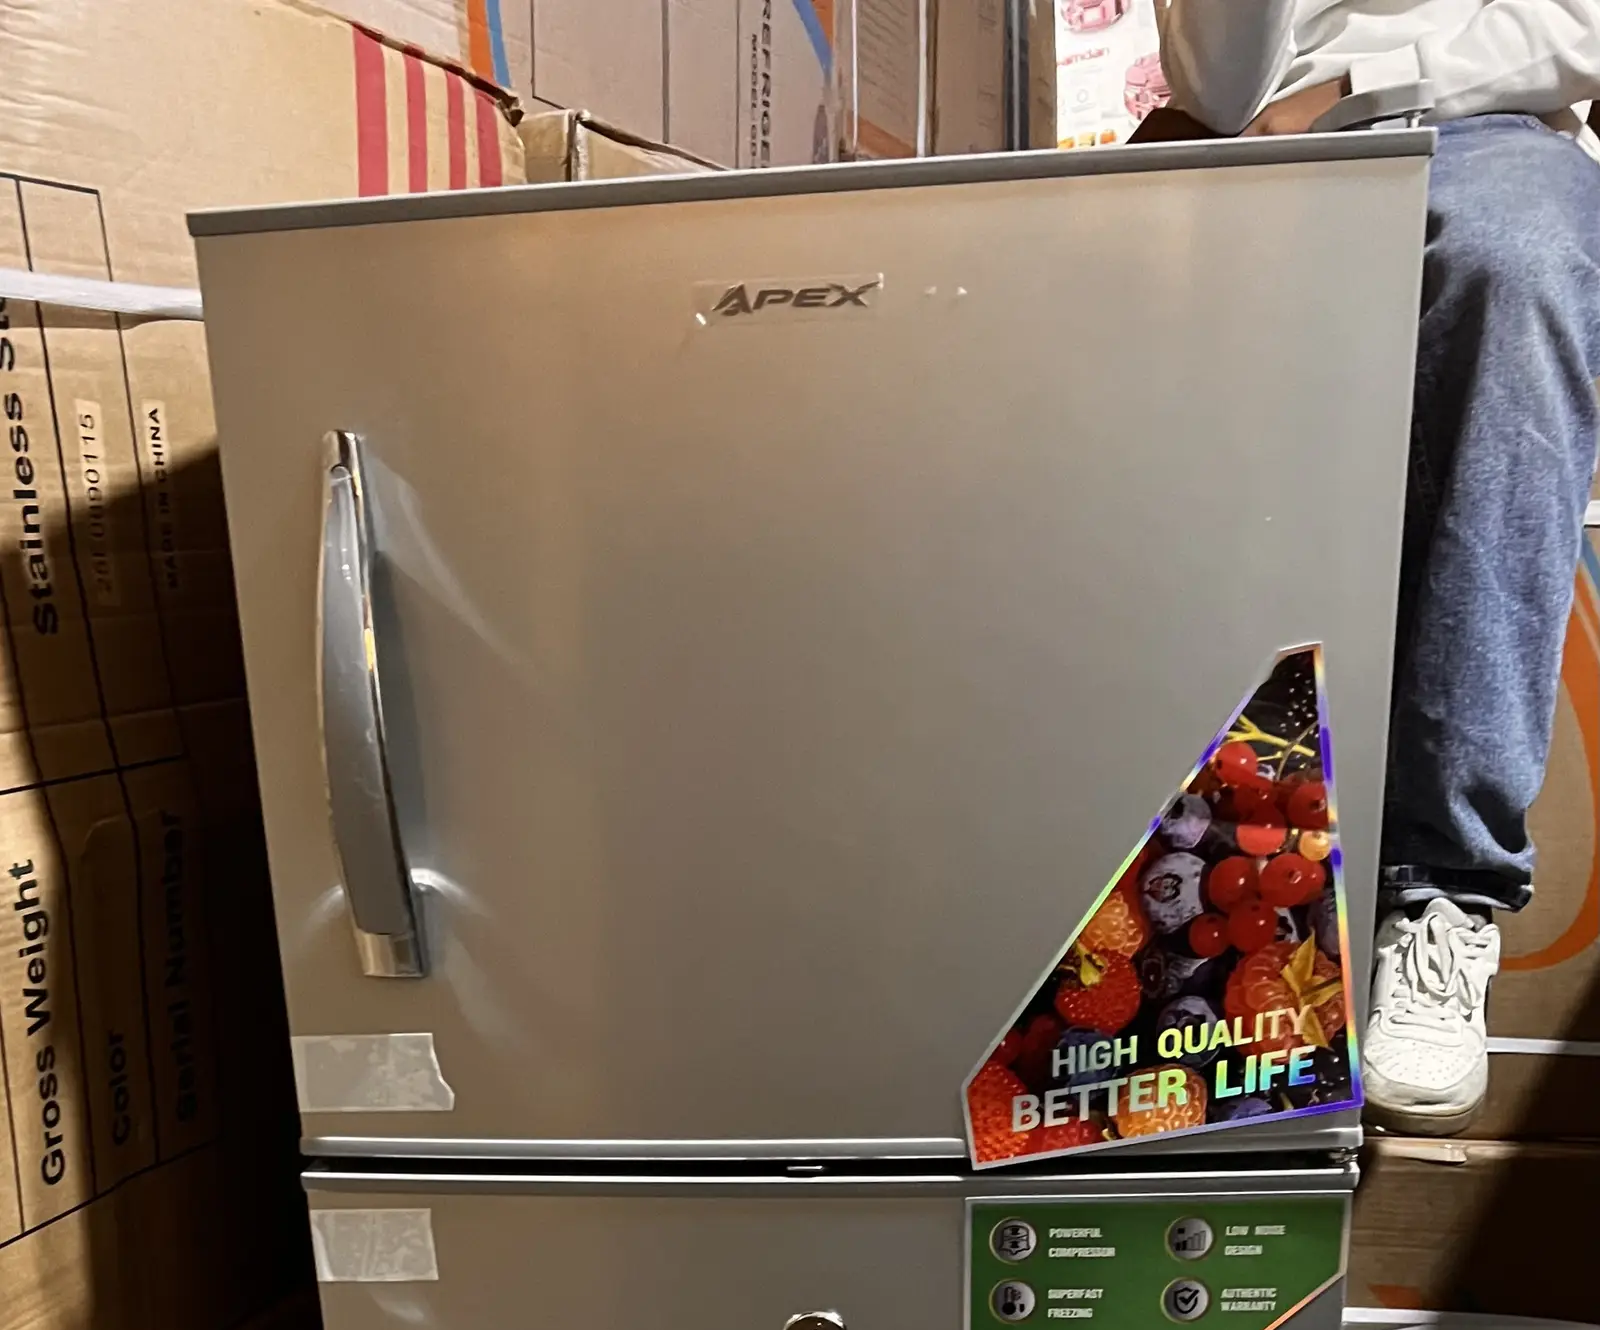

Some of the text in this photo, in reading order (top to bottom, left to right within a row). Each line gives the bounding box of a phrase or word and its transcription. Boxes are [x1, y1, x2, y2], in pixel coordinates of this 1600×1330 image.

[760, 0, 771, 168] REFRIGE
[712, 281, 880, 316] APEX
[147, 408, 169, 484] CHINA
[4, 393, 59, 635] Stainless
[158, 809, 199, 1123] Serial Number
[8, 859, 66, 1185] Gross Weight
[1052, 1004, 1311, 1078] HIGH QUALITY
[107, 1028, 132, 1146] Color
[1011, 1045, 1316, 1132] BETTER LIFE
[1048, 1227, 1103, 1239] POWERFUL
[1225, 1225, 1250, 1237] LOW
[1047, 1288, 1104, 1300] SUPERFAST
[1221, 1288, 1278, 1300] AUTHENTIC
[1221, 1301, 1277, 1312] WARRANTY
